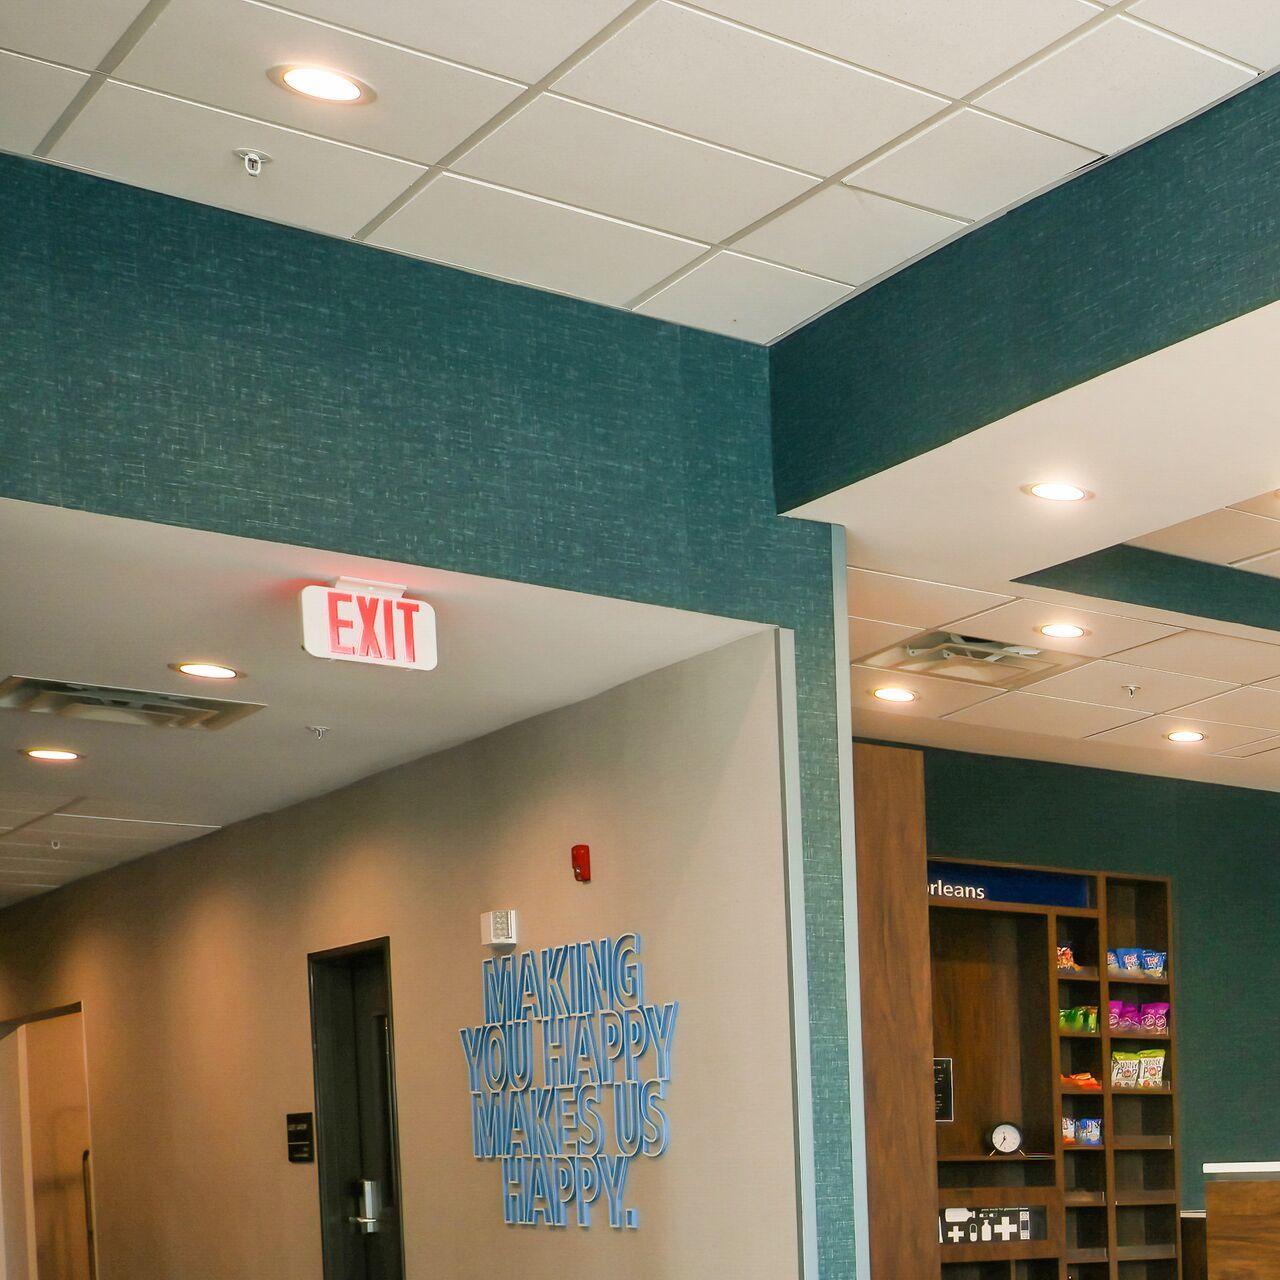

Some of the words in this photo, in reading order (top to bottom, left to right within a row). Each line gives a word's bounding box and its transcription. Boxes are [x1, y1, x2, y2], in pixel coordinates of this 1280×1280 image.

[327, 591, 420, 663] EXIT
[927, 879, 985, 899] rleans
[482, 933, 644, 1025] MAKING
[459, 1019, 533, 1093] YOU
[542, 1000, 680, 1088] HAPPY
[470, 1082, 603, 1159] MAKES
[613, 1077, 670, 1158] US
[500, 1154, 640, 1229] HAPPY.
